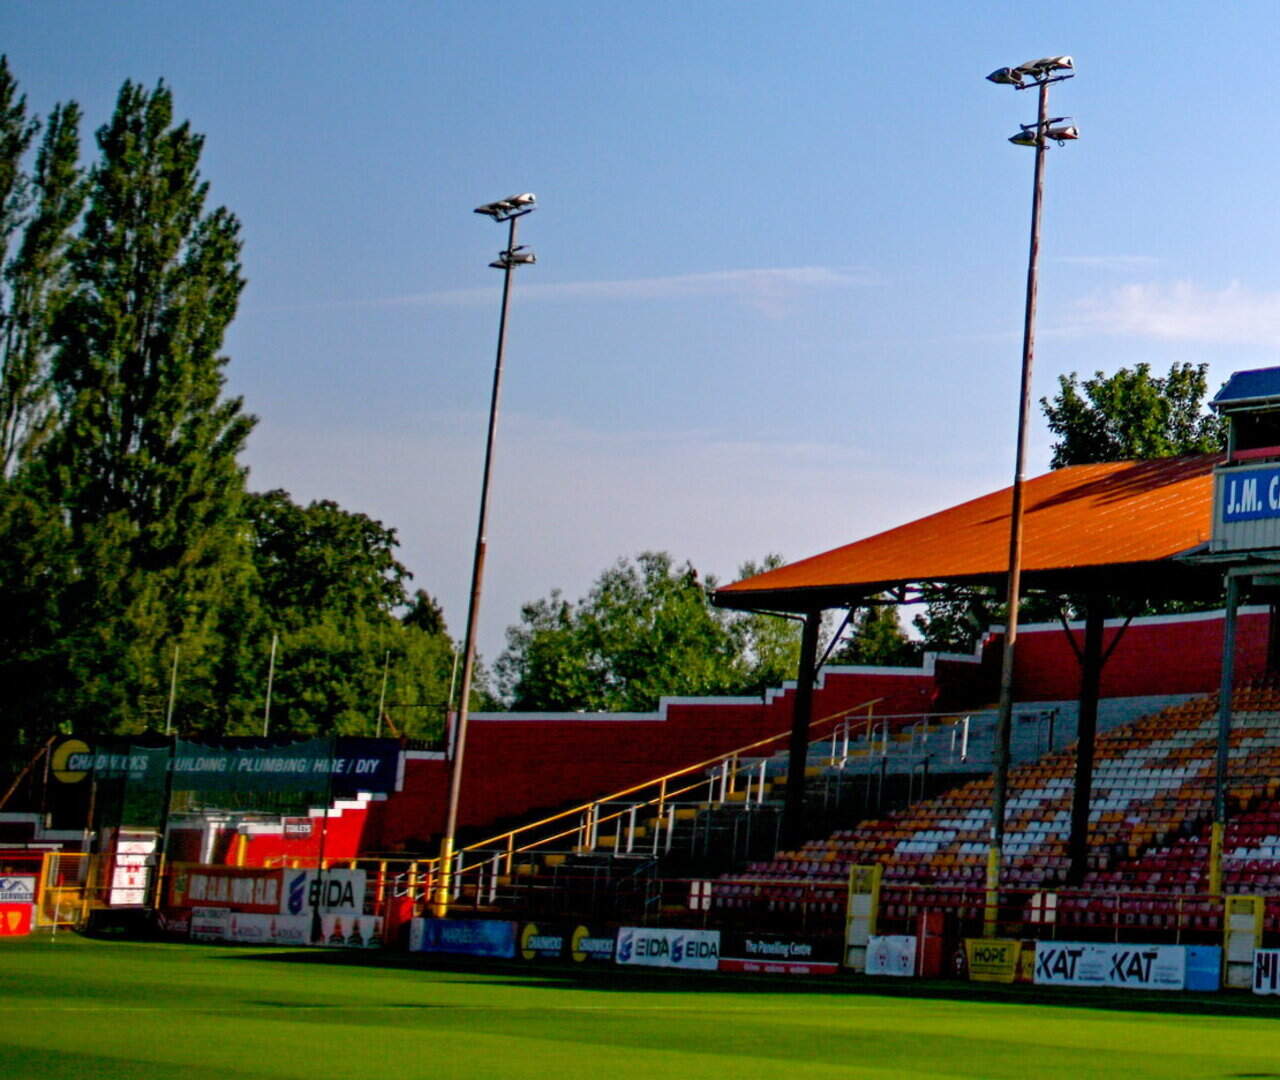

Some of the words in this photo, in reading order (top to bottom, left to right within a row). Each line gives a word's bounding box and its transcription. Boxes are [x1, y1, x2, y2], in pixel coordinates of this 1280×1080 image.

[1227, 479, 1262, 514] J.M.
[237, 757, 306, 773] PLUMBING
[355, 758, 381, 775] DIY
[635, 938, 669, 957] EIDA
[685, 940, 718, 959] EIDA
[1037, 948, 1083, 980] KAT
[1109, 951, 1158, 984] KAT
